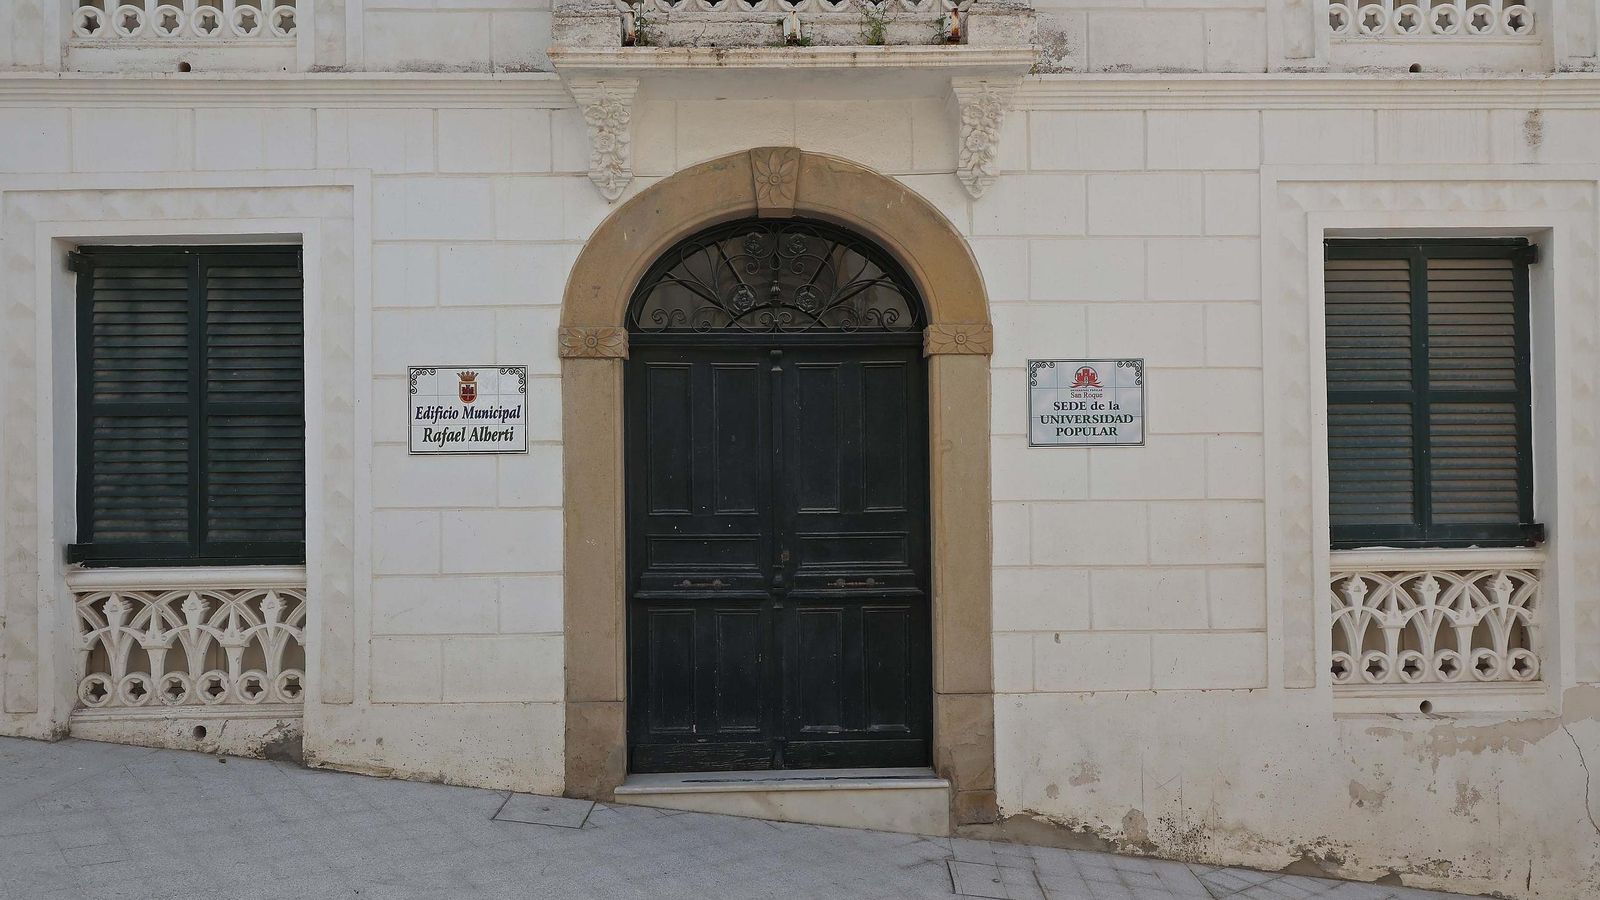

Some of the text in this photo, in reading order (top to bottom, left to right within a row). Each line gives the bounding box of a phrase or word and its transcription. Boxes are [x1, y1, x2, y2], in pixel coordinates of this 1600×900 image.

[1053, 401, 1120, 411] SEDE de la
[415, 405, 521, 424] Edificio Municipal
[1040, 414, 1134, 424] UNIVERSIDAD
[1055, 426, 1118, 436] POPULAR
[422, 426, 514, 448] Rafael Alberti
